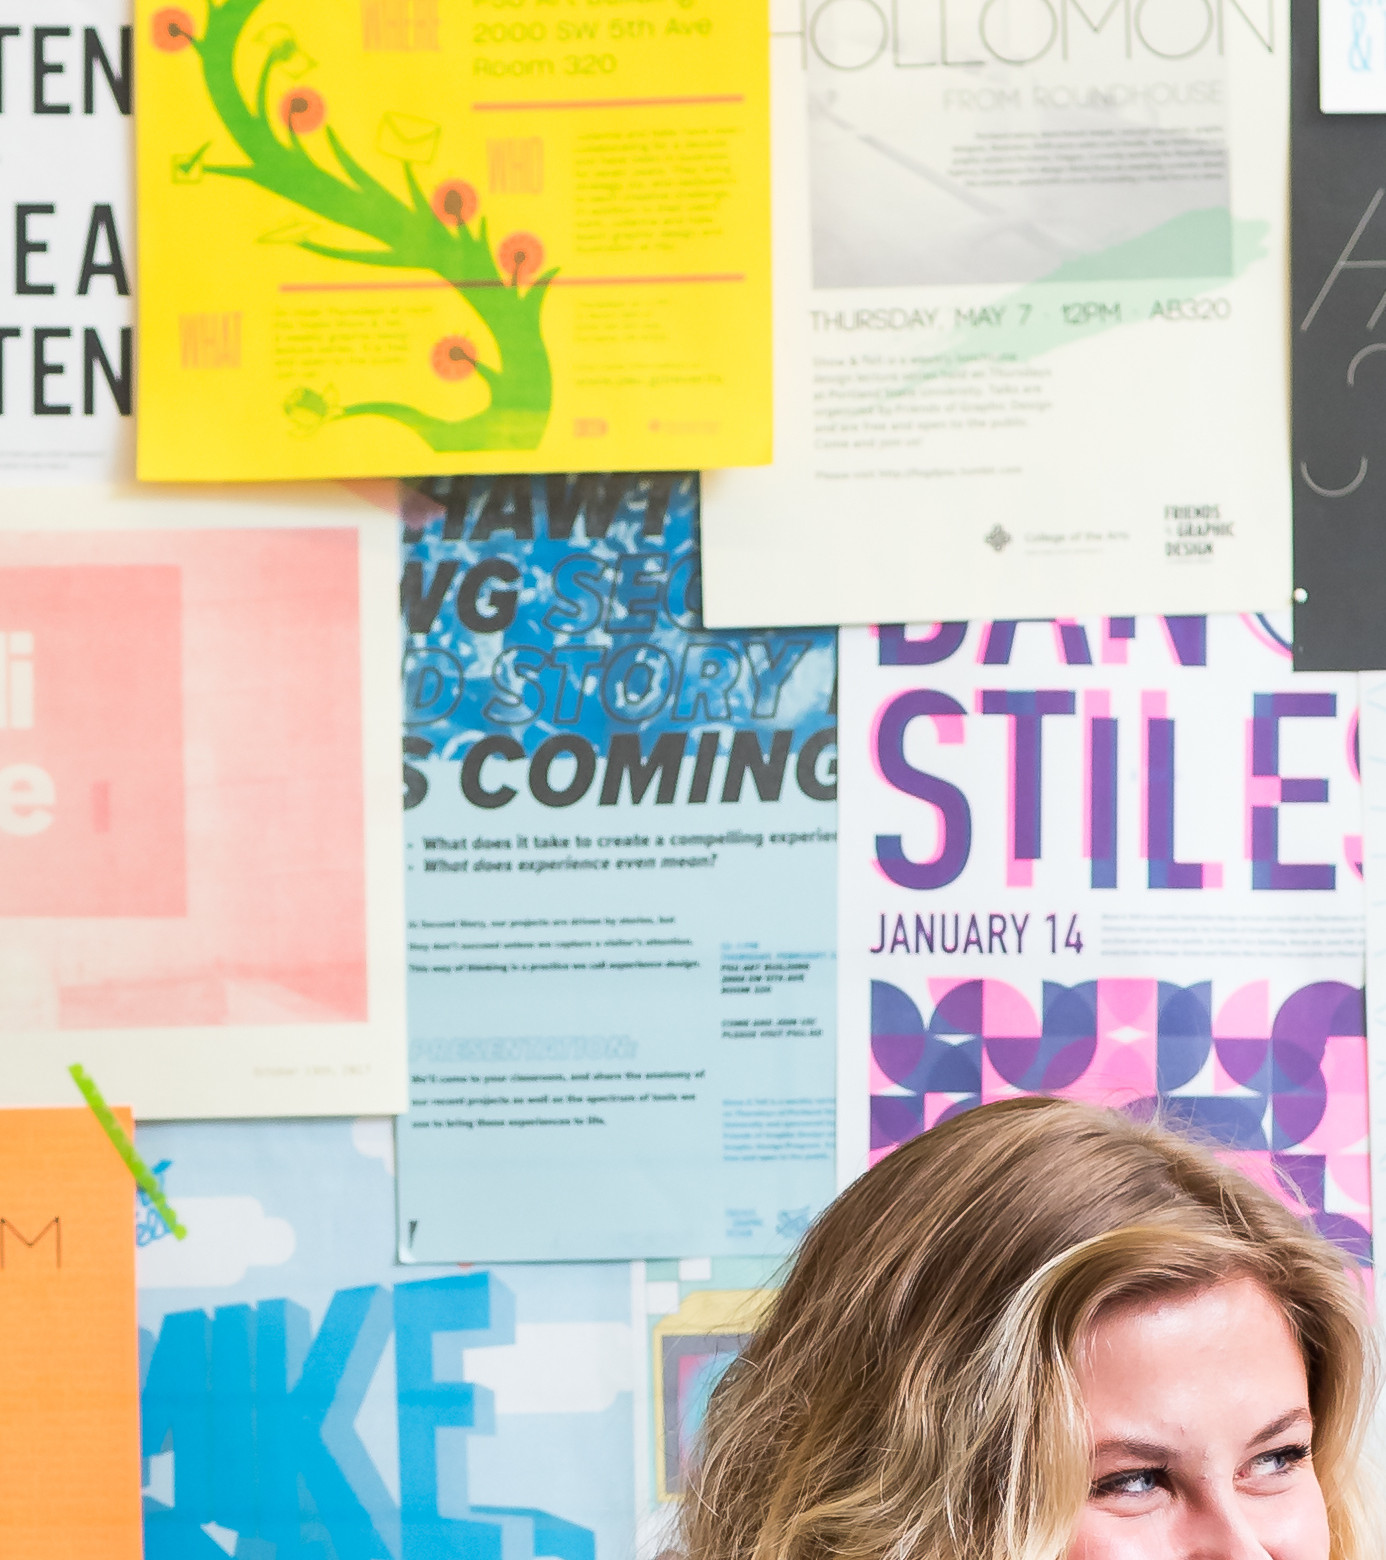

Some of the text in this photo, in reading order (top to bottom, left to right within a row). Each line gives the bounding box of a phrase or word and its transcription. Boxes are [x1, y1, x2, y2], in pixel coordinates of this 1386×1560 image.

[955, 304, 1008, 330] MAY
[1061, 300, 1122, 326] 12PM
[1149, 296, 1231, 324] AB320
[870, 912, 1033, 955] JANUARY
[1047, 914, 1085, 955] 14
